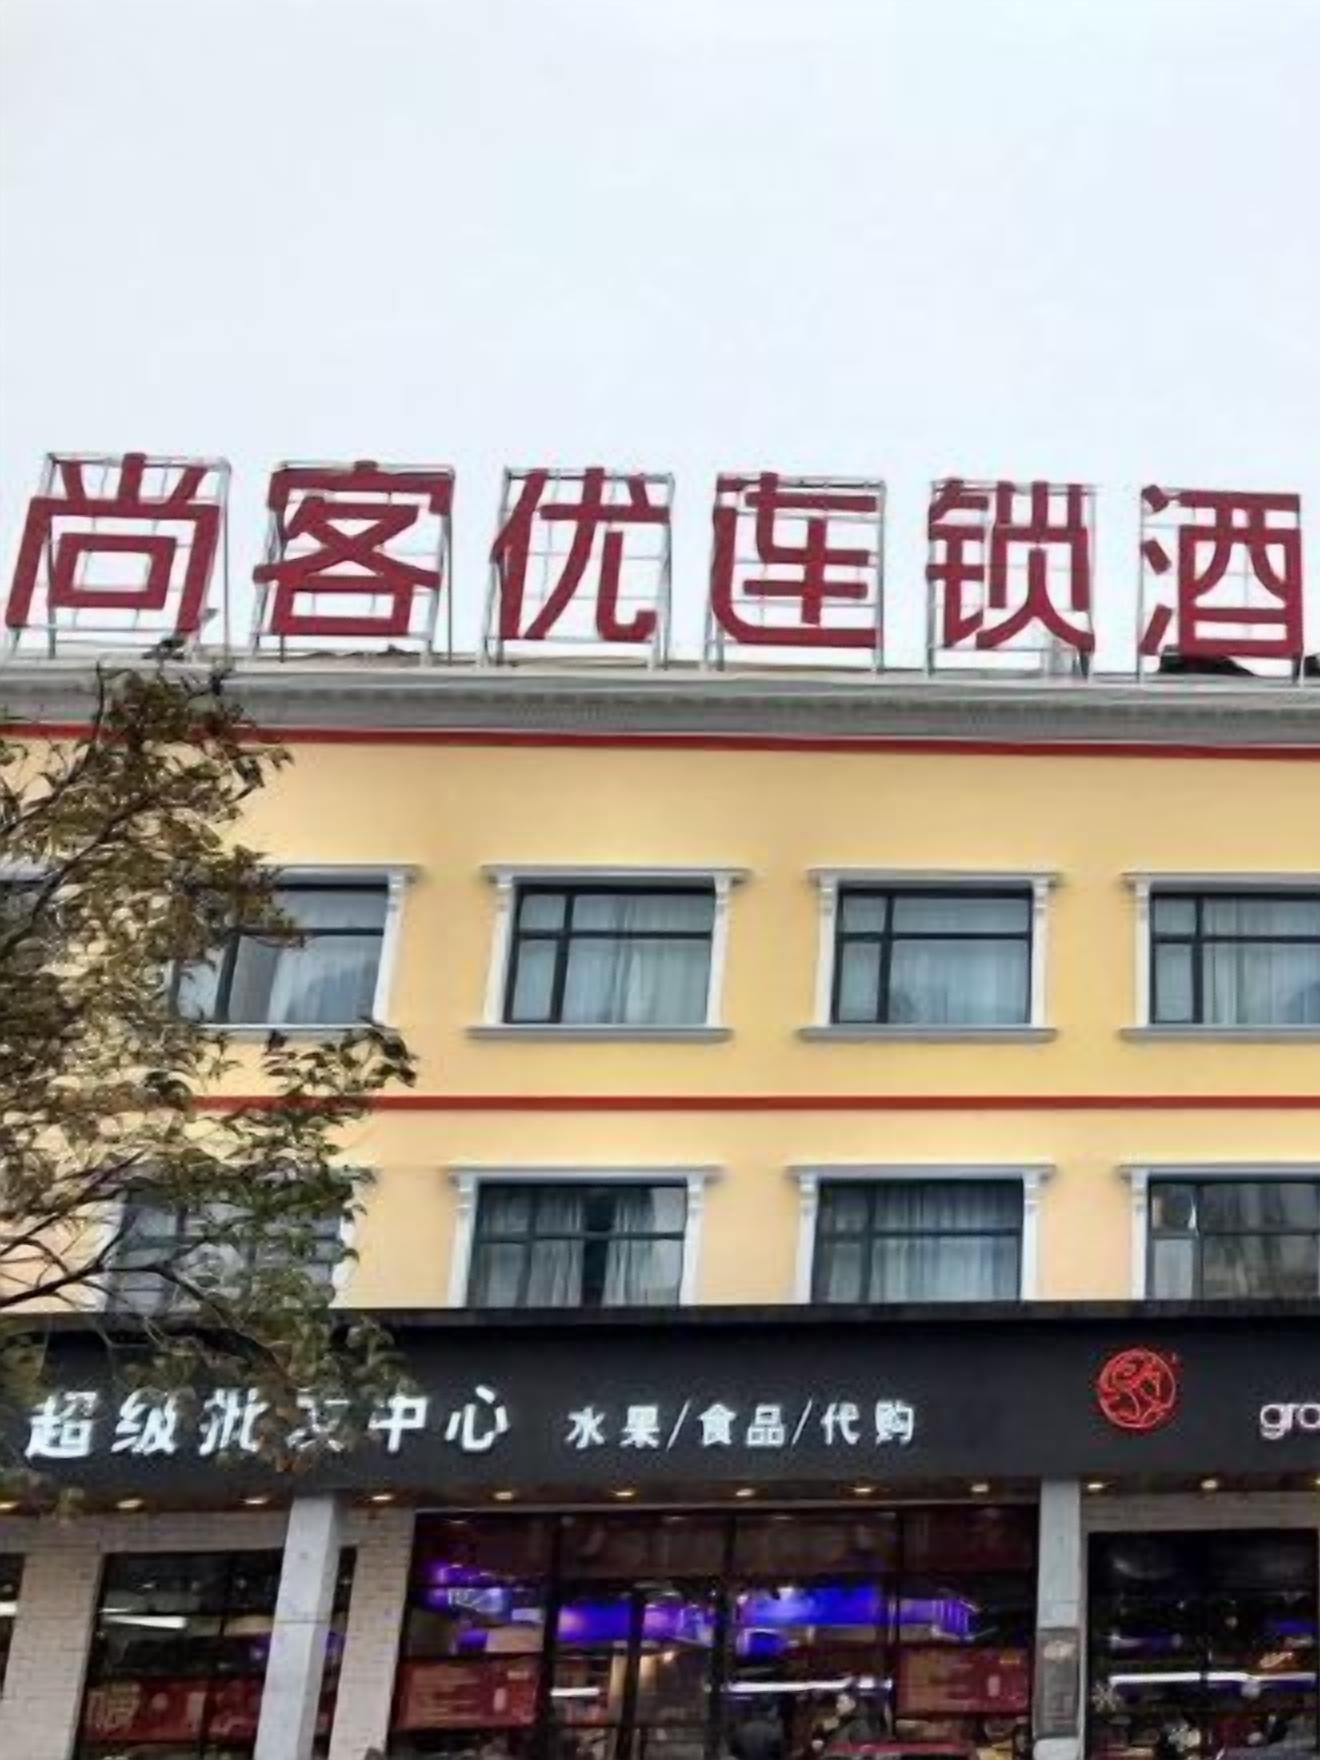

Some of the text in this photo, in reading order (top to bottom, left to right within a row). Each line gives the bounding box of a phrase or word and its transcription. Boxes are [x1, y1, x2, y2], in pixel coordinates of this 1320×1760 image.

[565, 1399, 915, 1450] 水果/食品/代购
